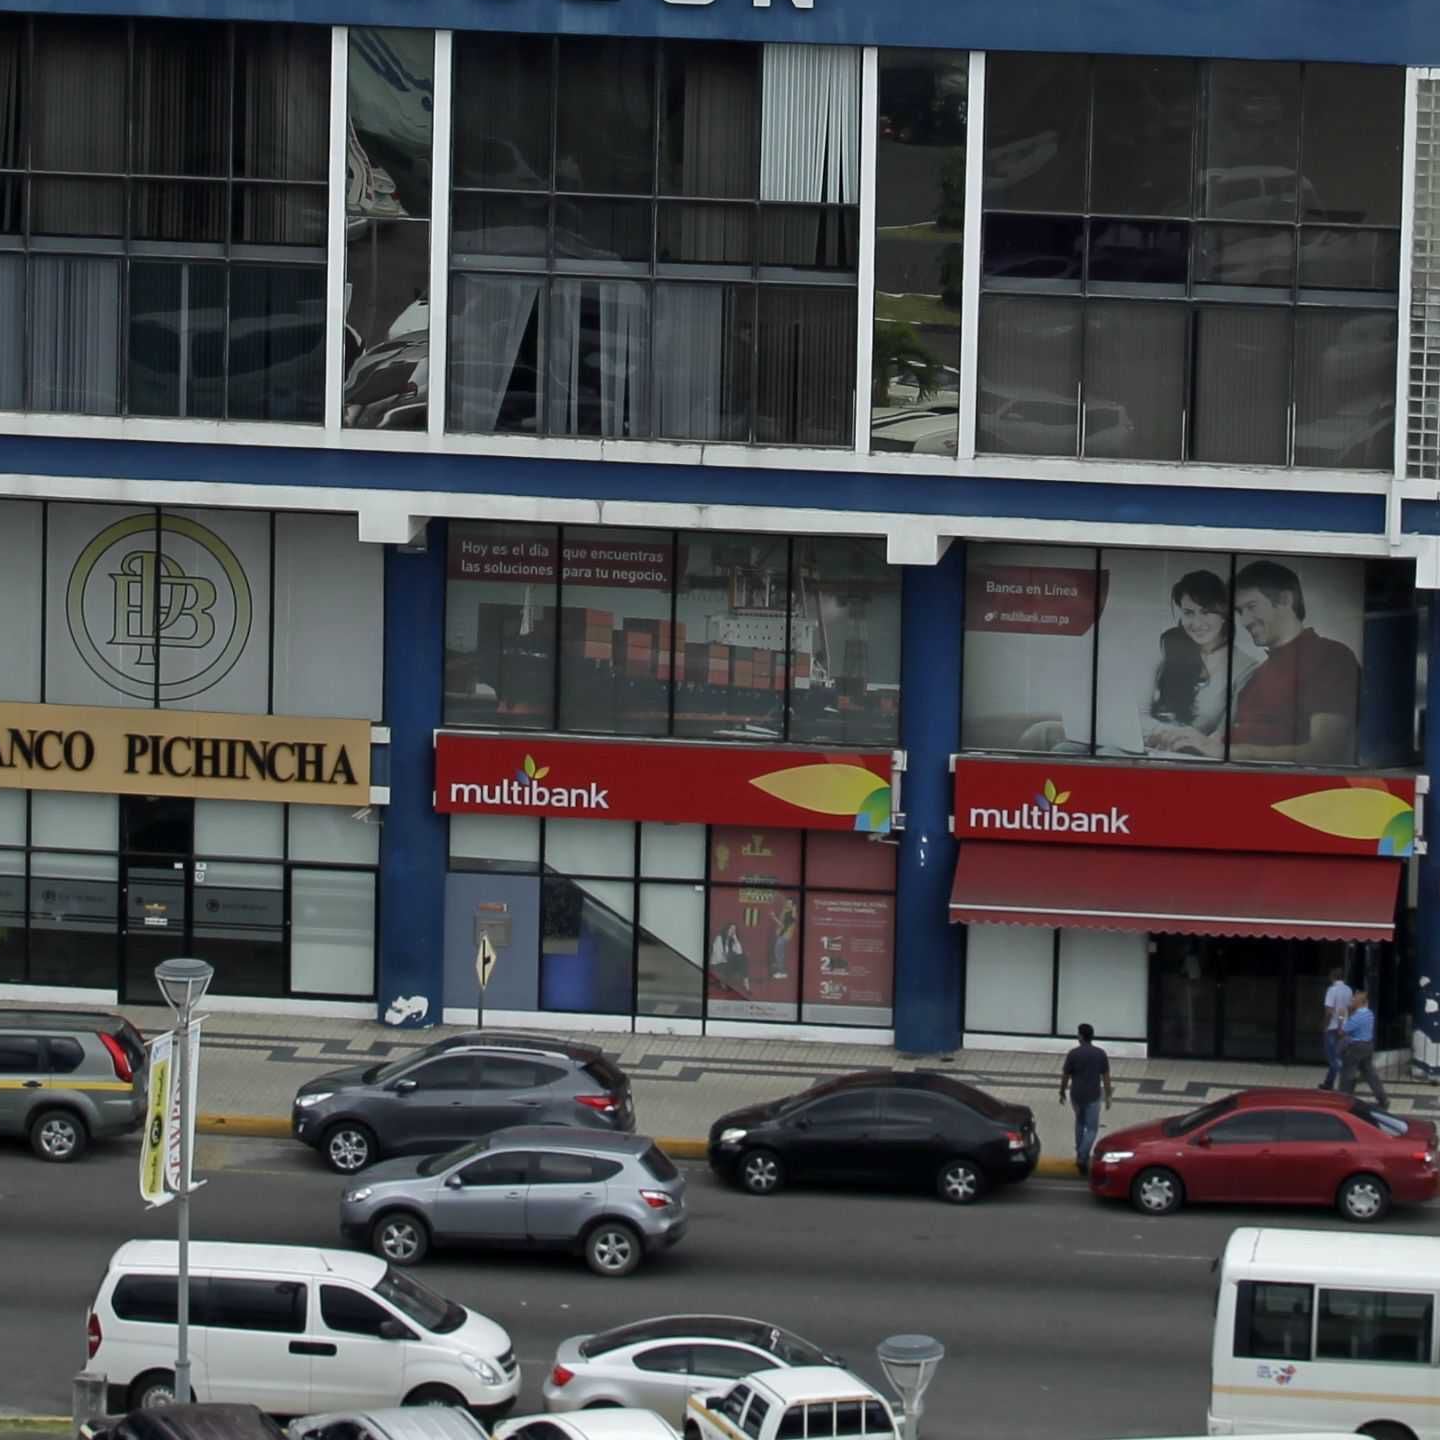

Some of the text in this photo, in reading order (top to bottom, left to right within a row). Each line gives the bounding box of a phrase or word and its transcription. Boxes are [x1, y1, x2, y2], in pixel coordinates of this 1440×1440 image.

[461, 540, 488, 558] Hoy
[492, 544, 508, 557] es
[511, 542, 525, 557] el
[562, 547, 588, 562] que
[590, 547, 665, 563] encuentras
[461, 559, 668, 585] las soluciones para tu negocio.
[985, 580, 1024, 594] Banca
[1025, 584, 1042, 596] en
[123, 732, 358, 786] PICHINCHA
[450, 778, 609, 809] multibank
[969, 803, 1131, 835] multibank
